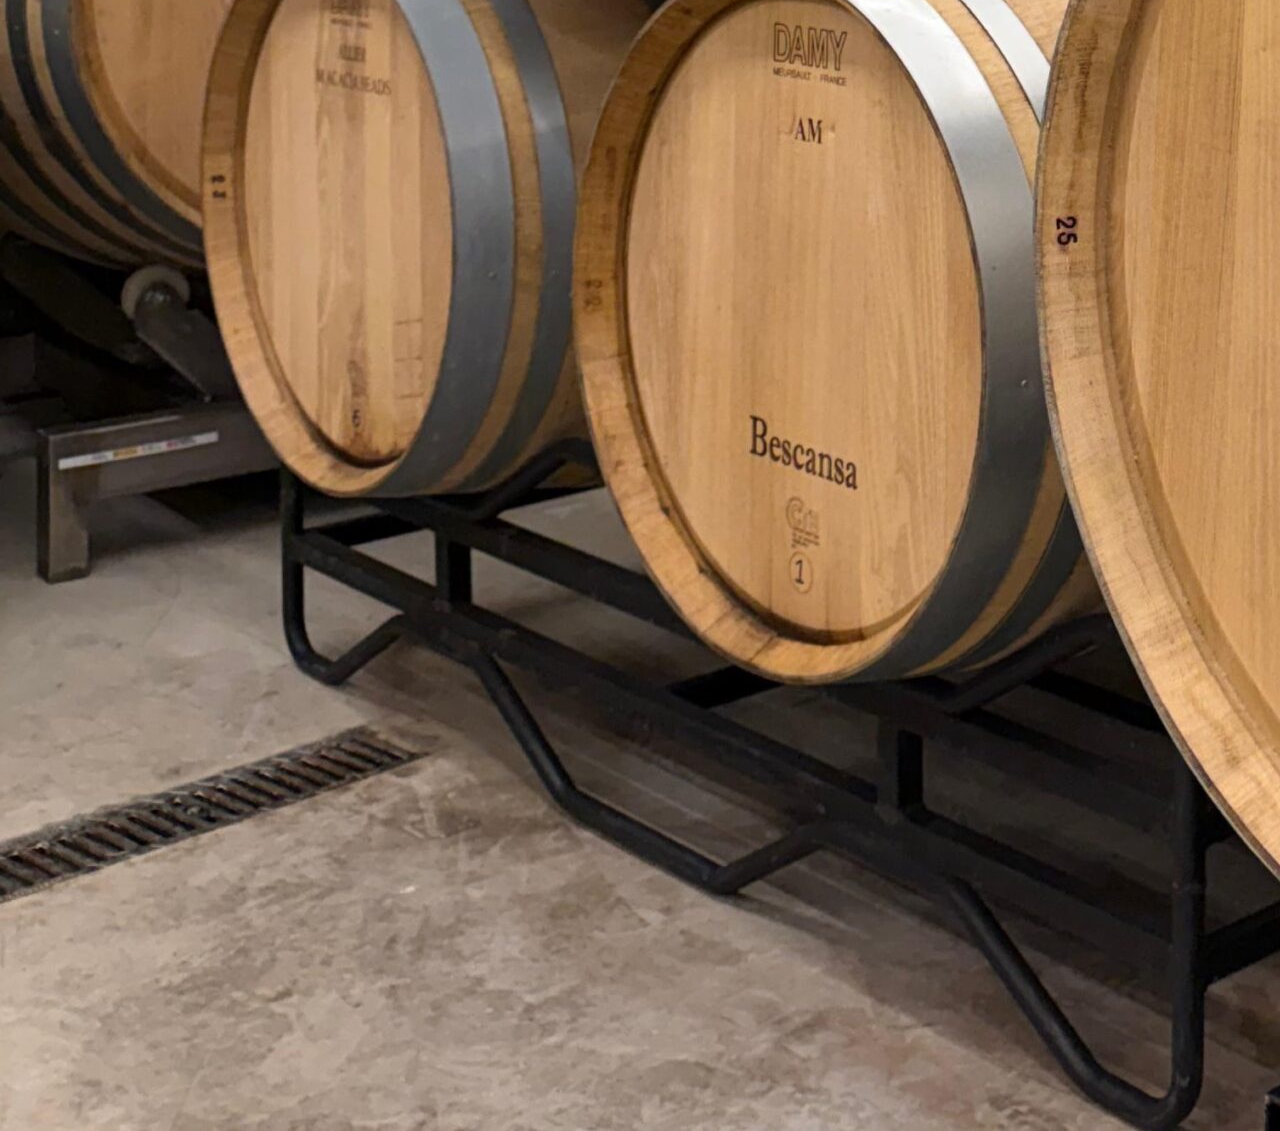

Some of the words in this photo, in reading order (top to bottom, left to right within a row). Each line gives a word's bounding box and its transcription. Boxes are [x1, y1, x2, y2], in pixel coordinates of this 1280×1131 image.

[772, 22, 847, 71] DAMY
[820, 74, 848, 86] FRANCE
[794, 117, 822, 144] AM
[1056, 216, 1078, 246] 25
[750, 414, 858, 490] Bescansa
[795, 559, 804, 584] 1
